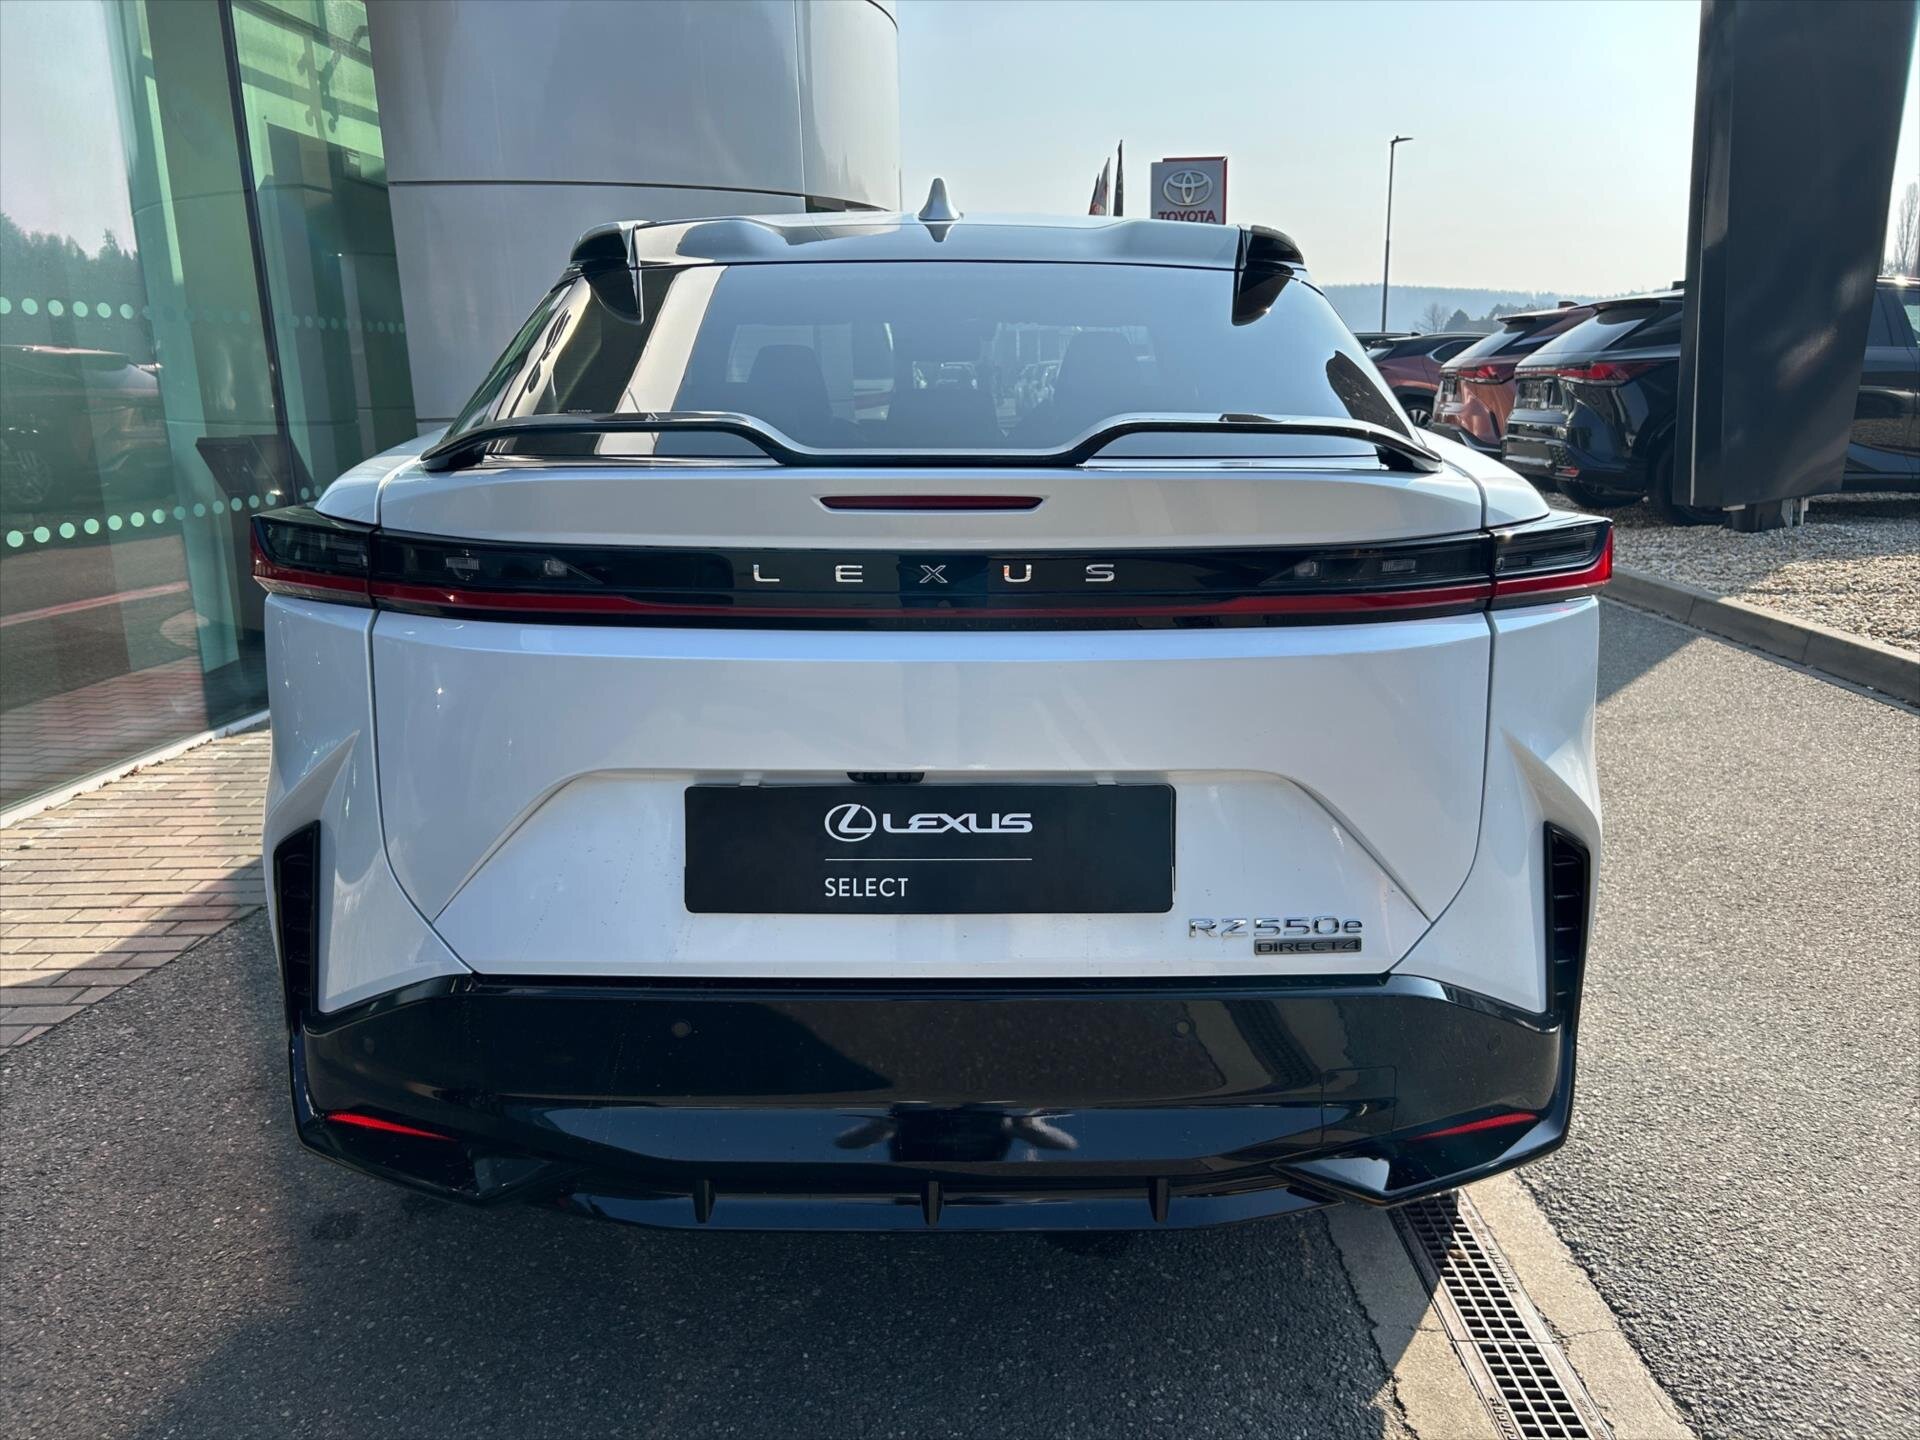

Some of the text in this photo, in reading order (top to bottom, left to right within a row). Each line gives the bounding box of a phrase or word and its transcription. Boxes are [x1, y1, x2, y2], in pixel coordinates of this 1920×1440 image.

[1158, 210, 1216, 222] TOYOTA
[753, 564, 1114, 583] LEXUS
[882, 813, 1033, 833] LEXUS
[824, 877, 908, 896] SELECT
